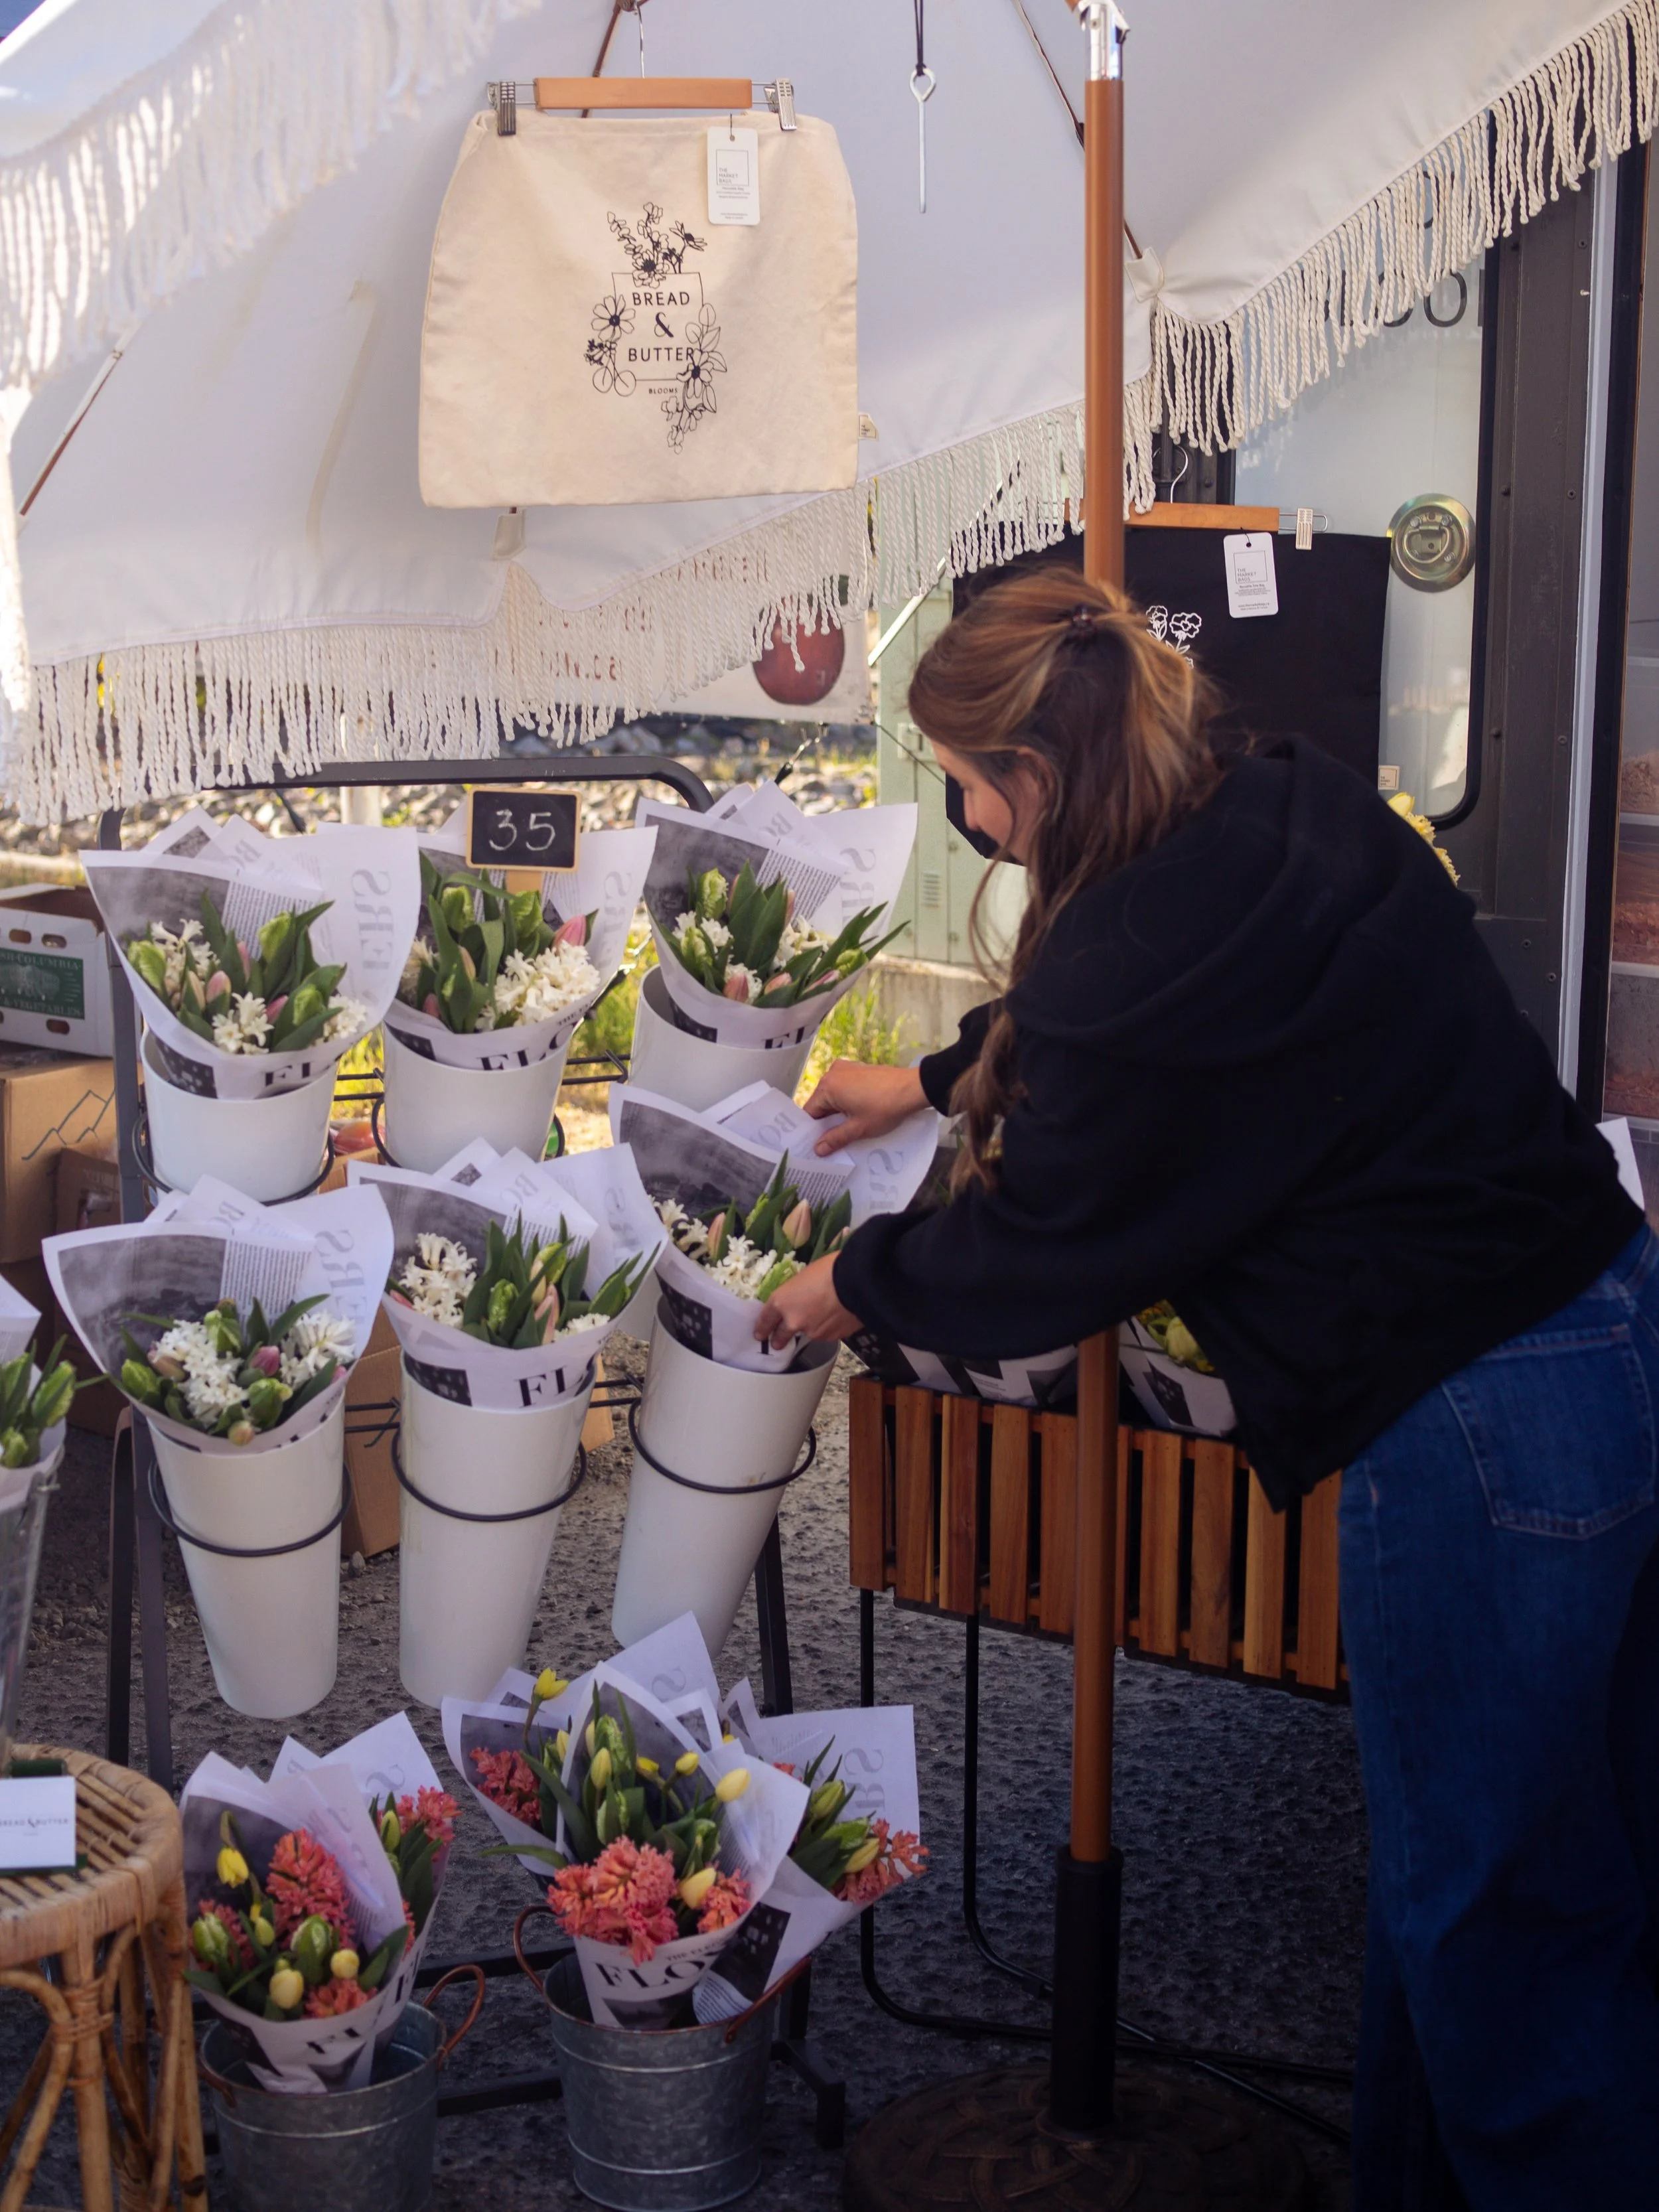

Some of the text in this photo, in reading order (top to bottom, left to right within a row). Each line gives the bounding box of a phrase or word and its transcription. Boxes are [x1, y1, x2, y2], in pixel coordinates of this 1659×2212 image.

[632, 291, 690, 307] BREAD
[654, 311, 674, 338] &
[628, 346, 695, 362] BUTTER
[488, 808, 556, 851] 35
[592, 1956, 711, 1988] FLO
